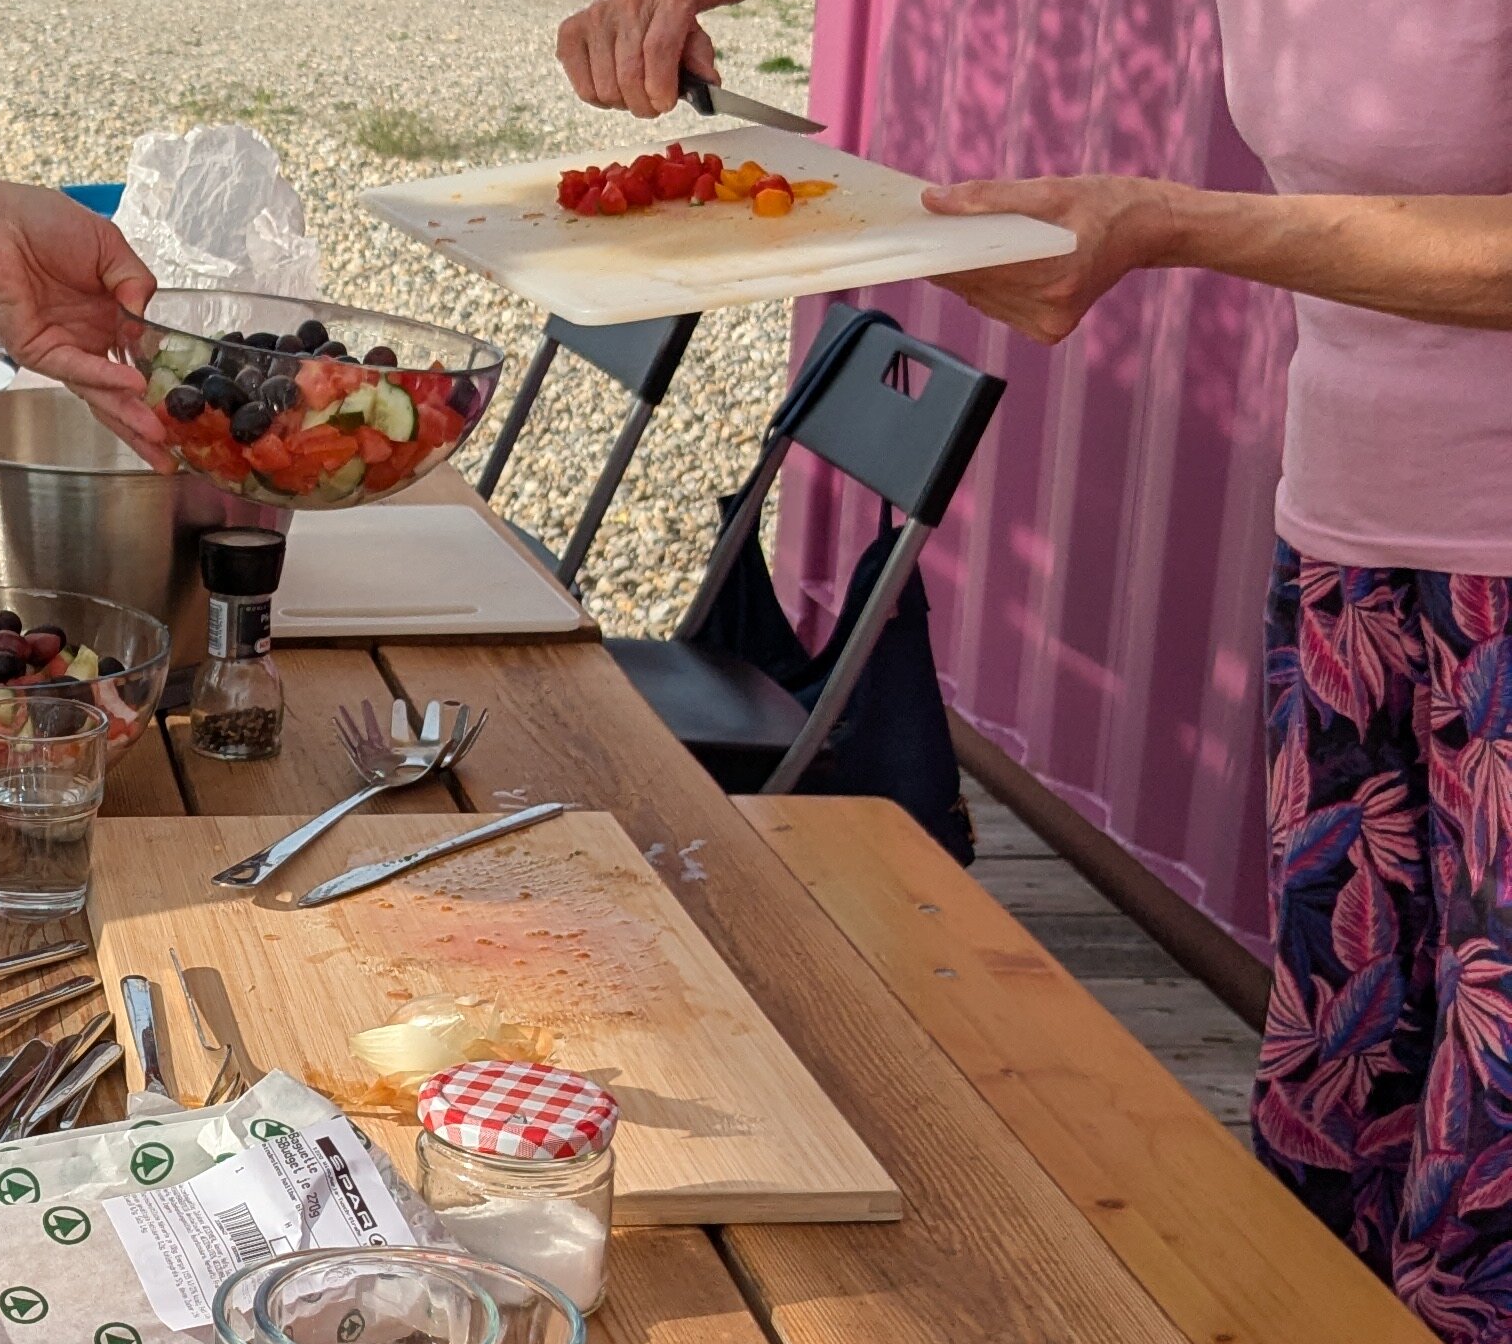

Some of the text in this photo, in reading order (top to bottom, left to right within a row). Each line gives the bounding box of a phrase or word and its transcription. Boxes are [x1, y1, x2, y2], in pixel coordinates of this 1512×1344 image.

[275, 1136, 320, 1219] SBudget je 270g
[288, 1131, 319, 1174] Baguette
[328, 1154, 375, 1229] SPAR
